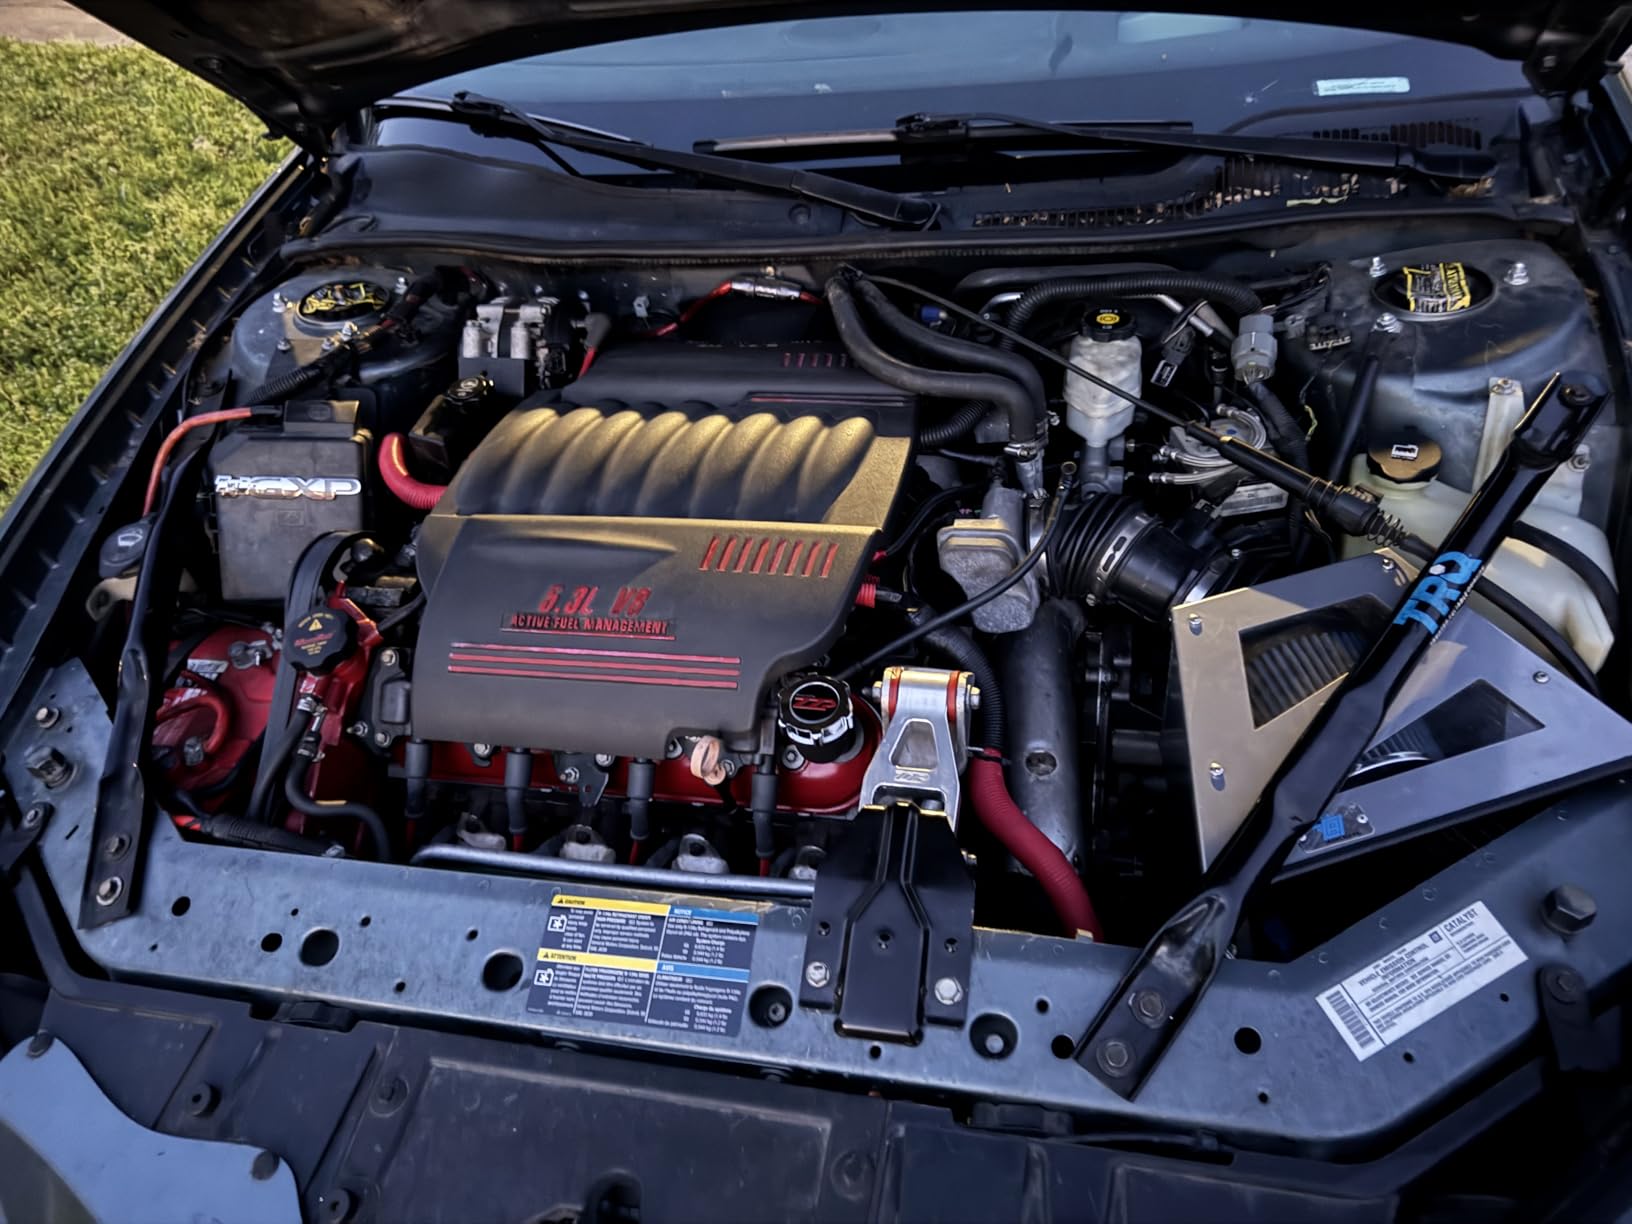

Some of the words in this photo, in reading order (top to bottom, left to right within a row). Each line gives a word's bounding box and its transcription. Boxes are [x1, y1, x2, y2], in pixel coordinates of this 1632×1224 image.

[610, 586, 652, 617] V8
[1392, 550, 1483, 635] TRQ
[511, 614, 554, 628] ACTIVE
[553, 616, 580, 630] FUEL
[583, 618, 668, 635] MANAGEMENT
[1442, 907, 1479, 933] CATALYST
